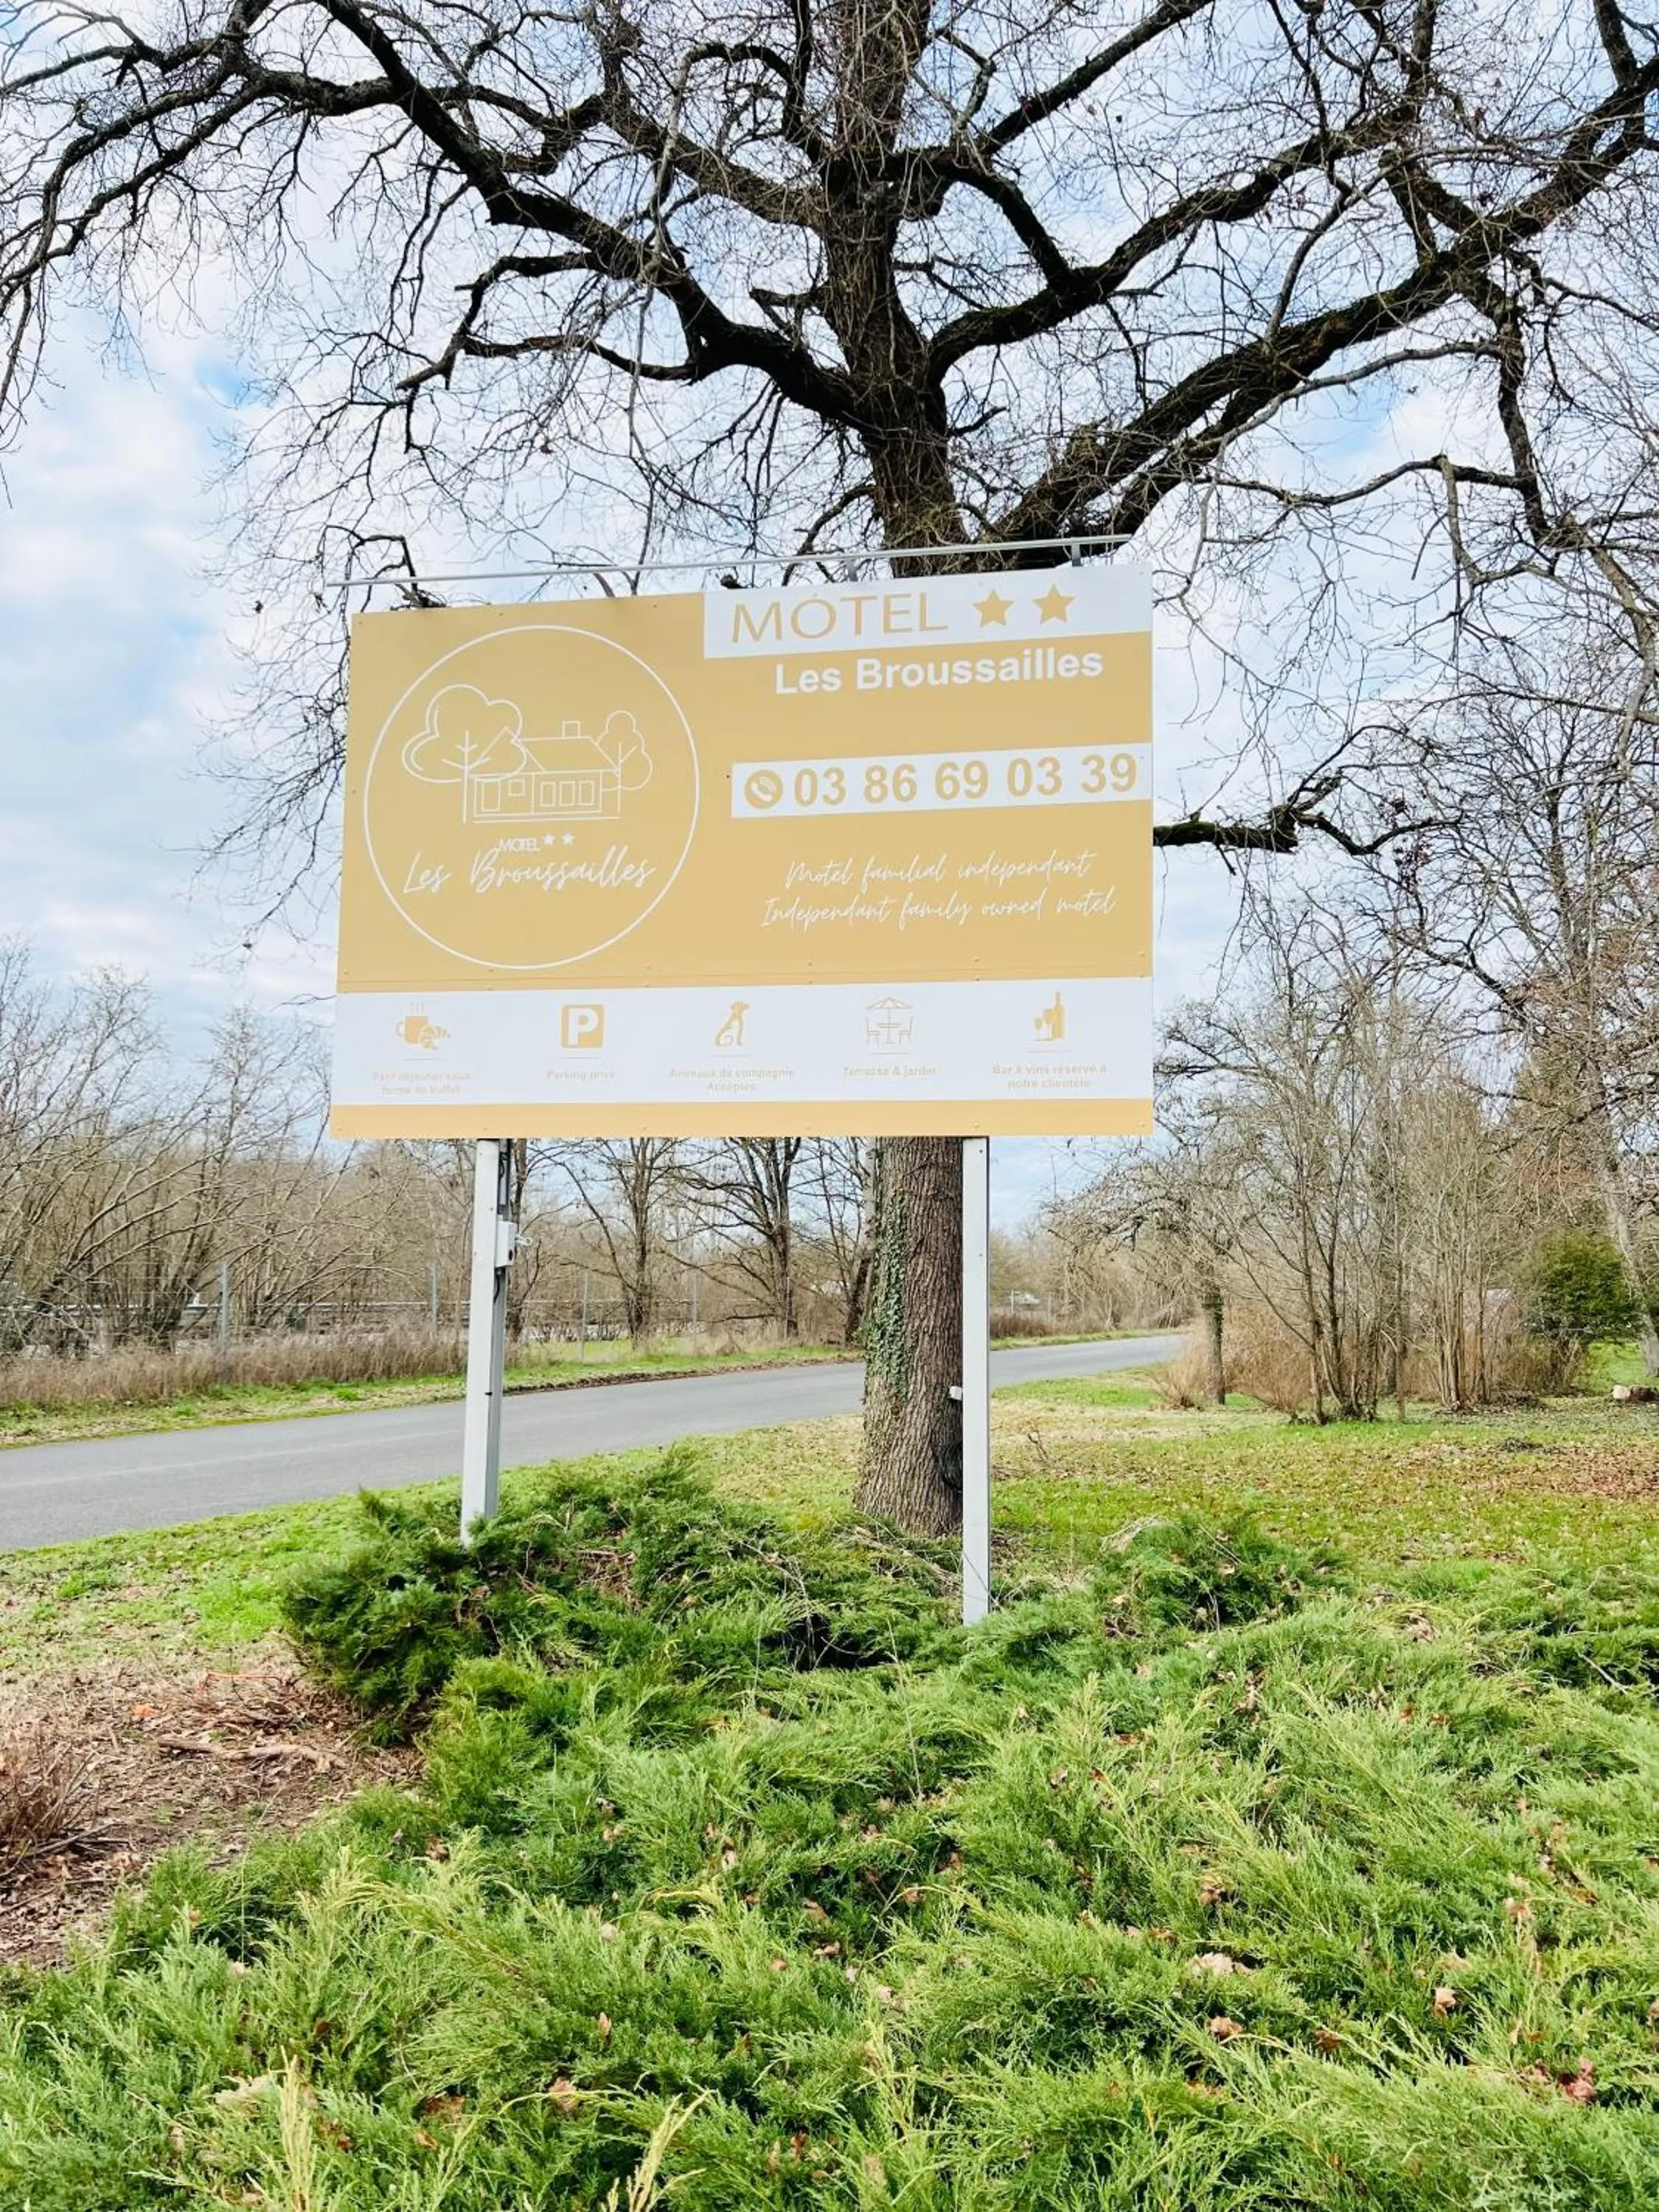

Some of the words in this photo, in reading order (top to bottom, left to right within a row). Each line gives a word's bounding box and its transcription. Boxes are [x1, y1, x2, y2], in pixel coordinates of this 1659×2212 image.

[731, 592, 949, 644] MOTEL
[775, 663, 842, 695] Les
[856, 648, 1104, 691] Broussailles
[794, 767, 846, 807] 03
[863, 764, 918, 804] 86
[934, 760, 990, 801] 69
[1007, 757, 1062, 797] 03
[1081, 753, 1137, 793] 39
[499, 837, 541, 852] MOTEL
[403, 852, 452, 894] Les
[470, 844, 657, 894] Broussailles
[785, 858, 854, 889] Motel
[899, 891, 972, 931] family
[981, 886, 1048, 920] owned
[1057, 885, 1116, 916] motel
[568, 1008, 599, 1045] P
